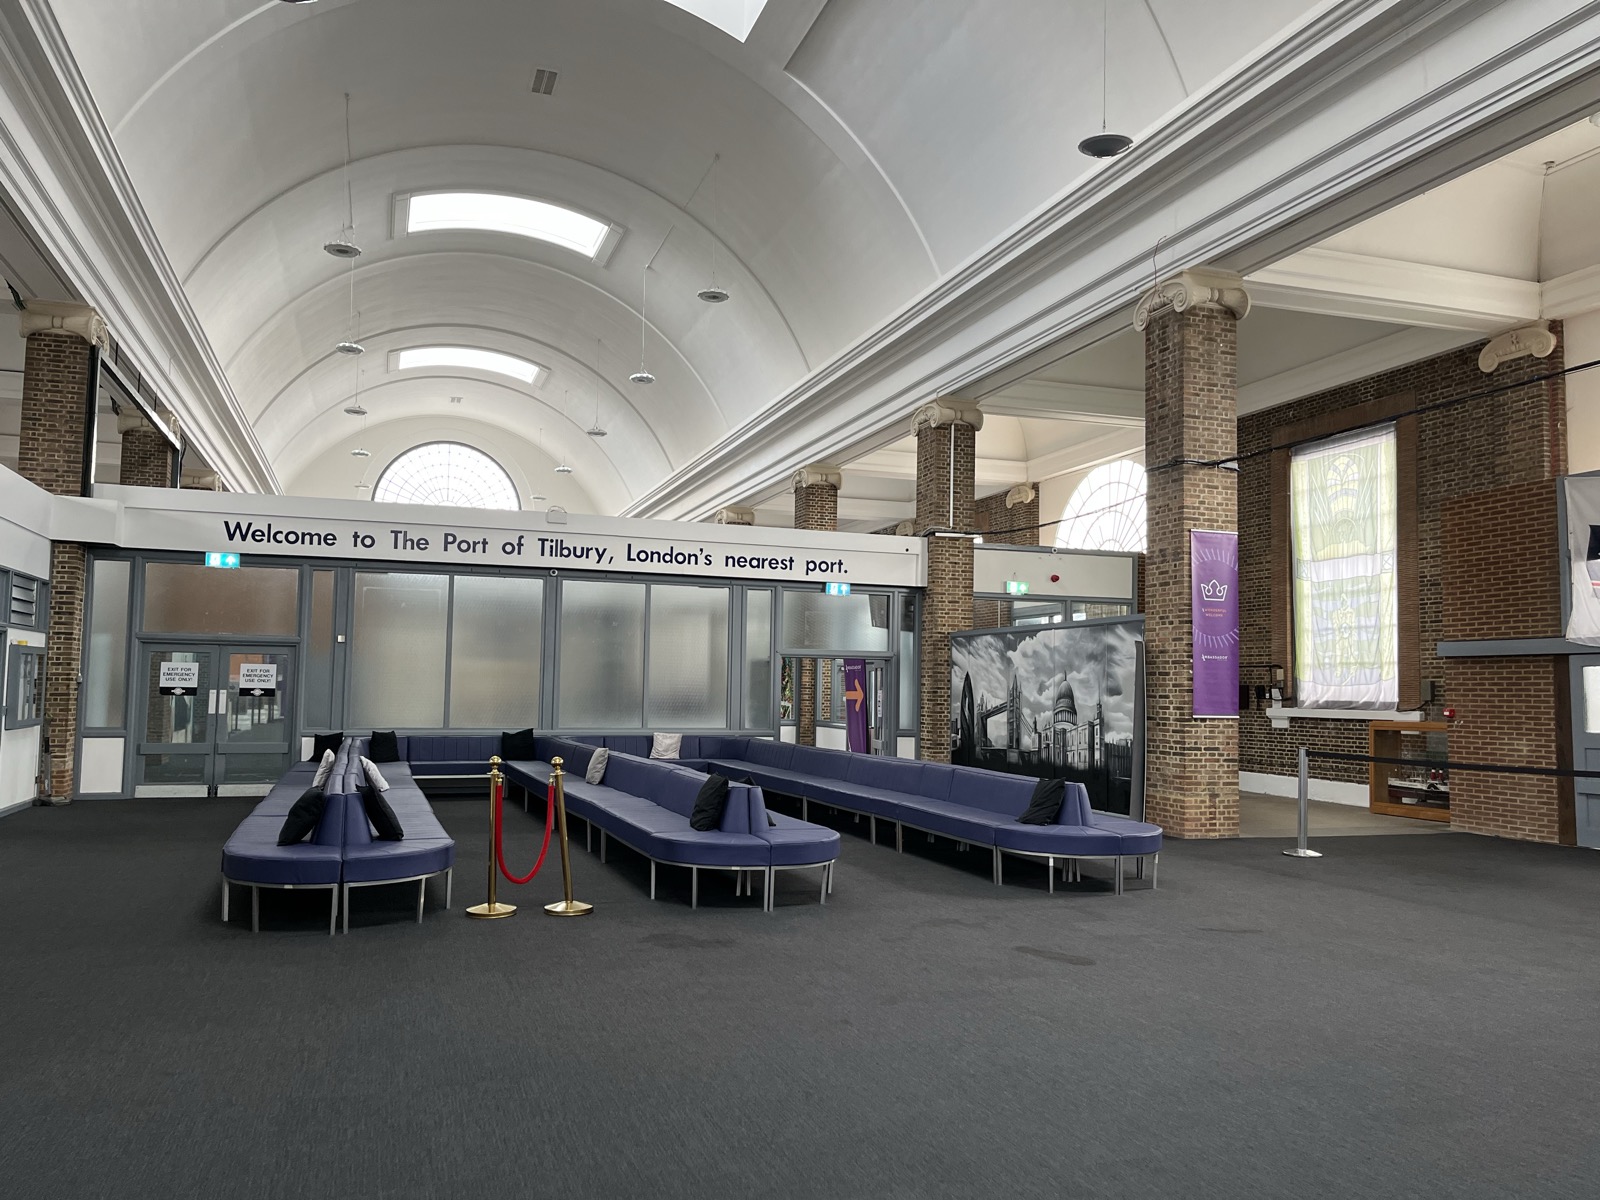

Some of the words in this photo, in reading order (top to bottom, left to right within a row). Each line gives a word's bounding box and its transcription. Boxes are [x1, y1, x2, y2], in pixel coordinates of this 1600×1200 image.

[223, 520, 338, 547] Welcome
[352, 531, 376, 549] to
[390, 529, 430, 551] The
[443, 532, 489, 554] Port
[501, 534, 525, 555] of
[537, 537, 614, 565] Tilbury,
[724, 555, 795, 571] nearest
[805, 559, 849, 576] port.
